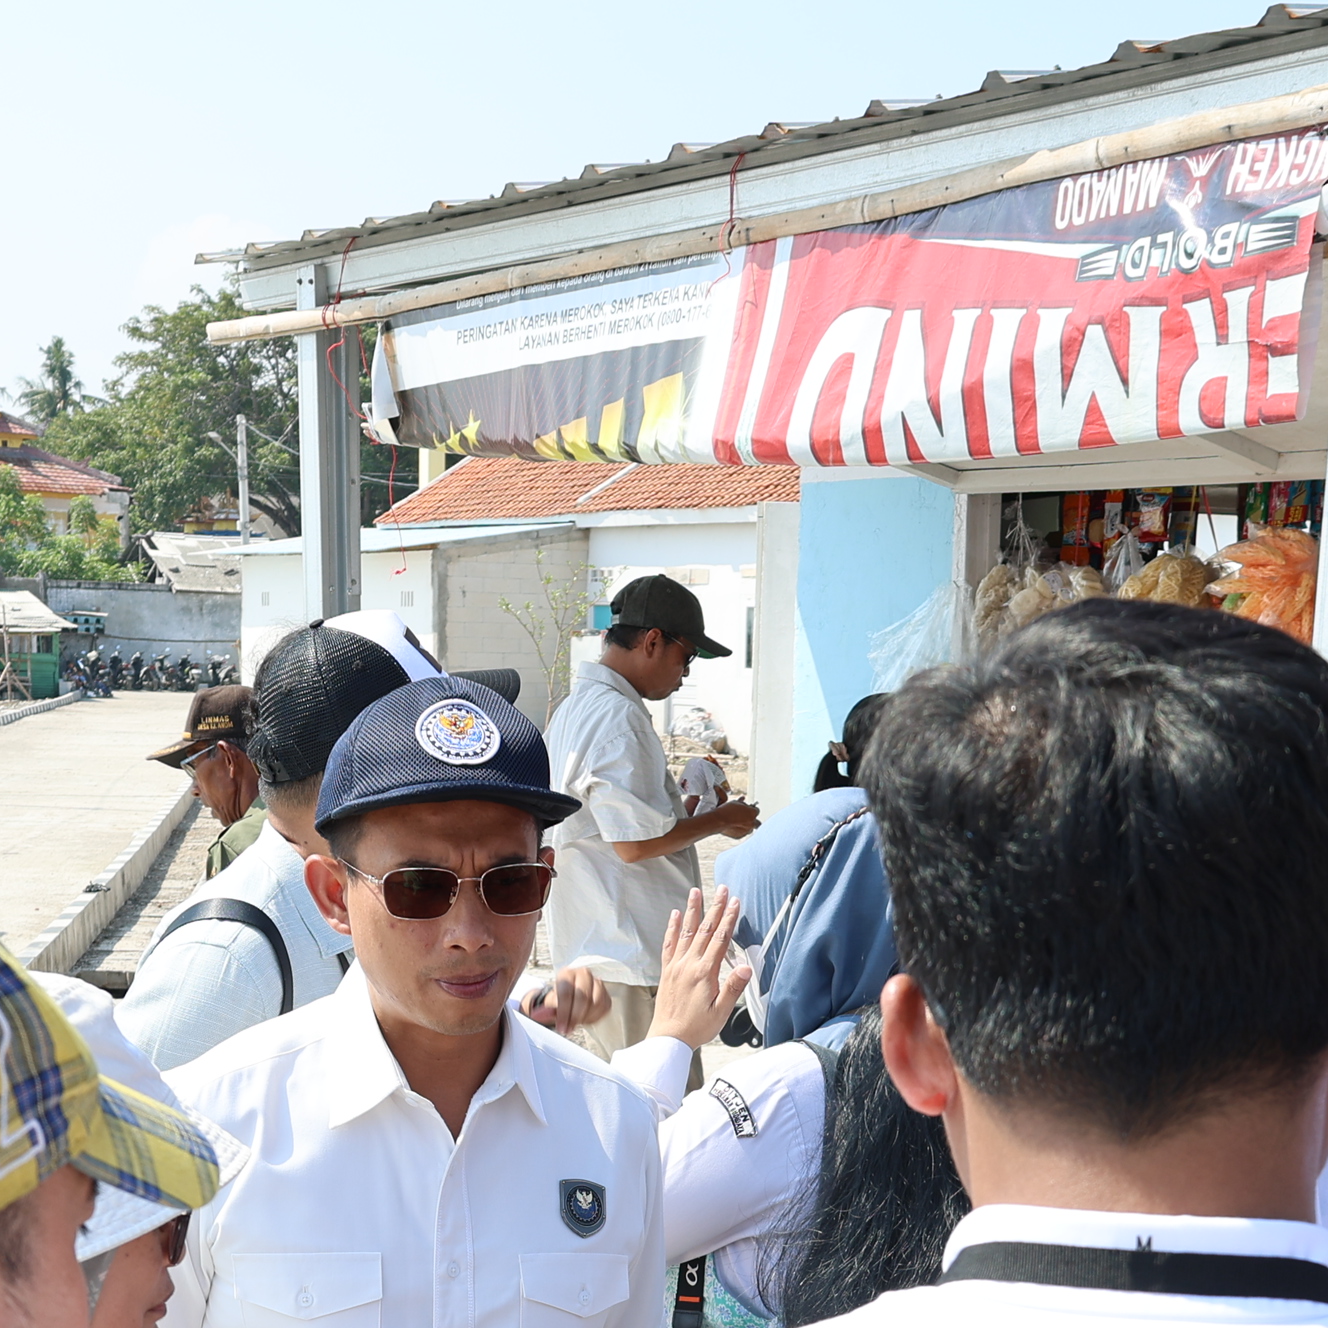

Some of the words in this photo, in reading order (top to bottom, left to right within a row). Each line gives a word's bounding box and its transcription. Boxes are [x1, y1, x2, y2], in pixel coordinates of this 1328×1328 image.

[1054, 156, 1170, 230] MANADO
[1123, 220, 1240, 282] BOLD
[457, 318, 518, 345] PERINGATAN
[520, 310, 558, 331] KARENA
[611, 297, 633, 315] SAYA
[636, 287, 680, 309] TERKENA
[519, 331, 560, 350] LAYANAN
[562, 321, 607, 344] BERHENTI
[608, 312, 656, 335] MEROKOK
[201, 715, 230, 724] LINMAS
[722, 1086, 750, 1123] DITJEN
